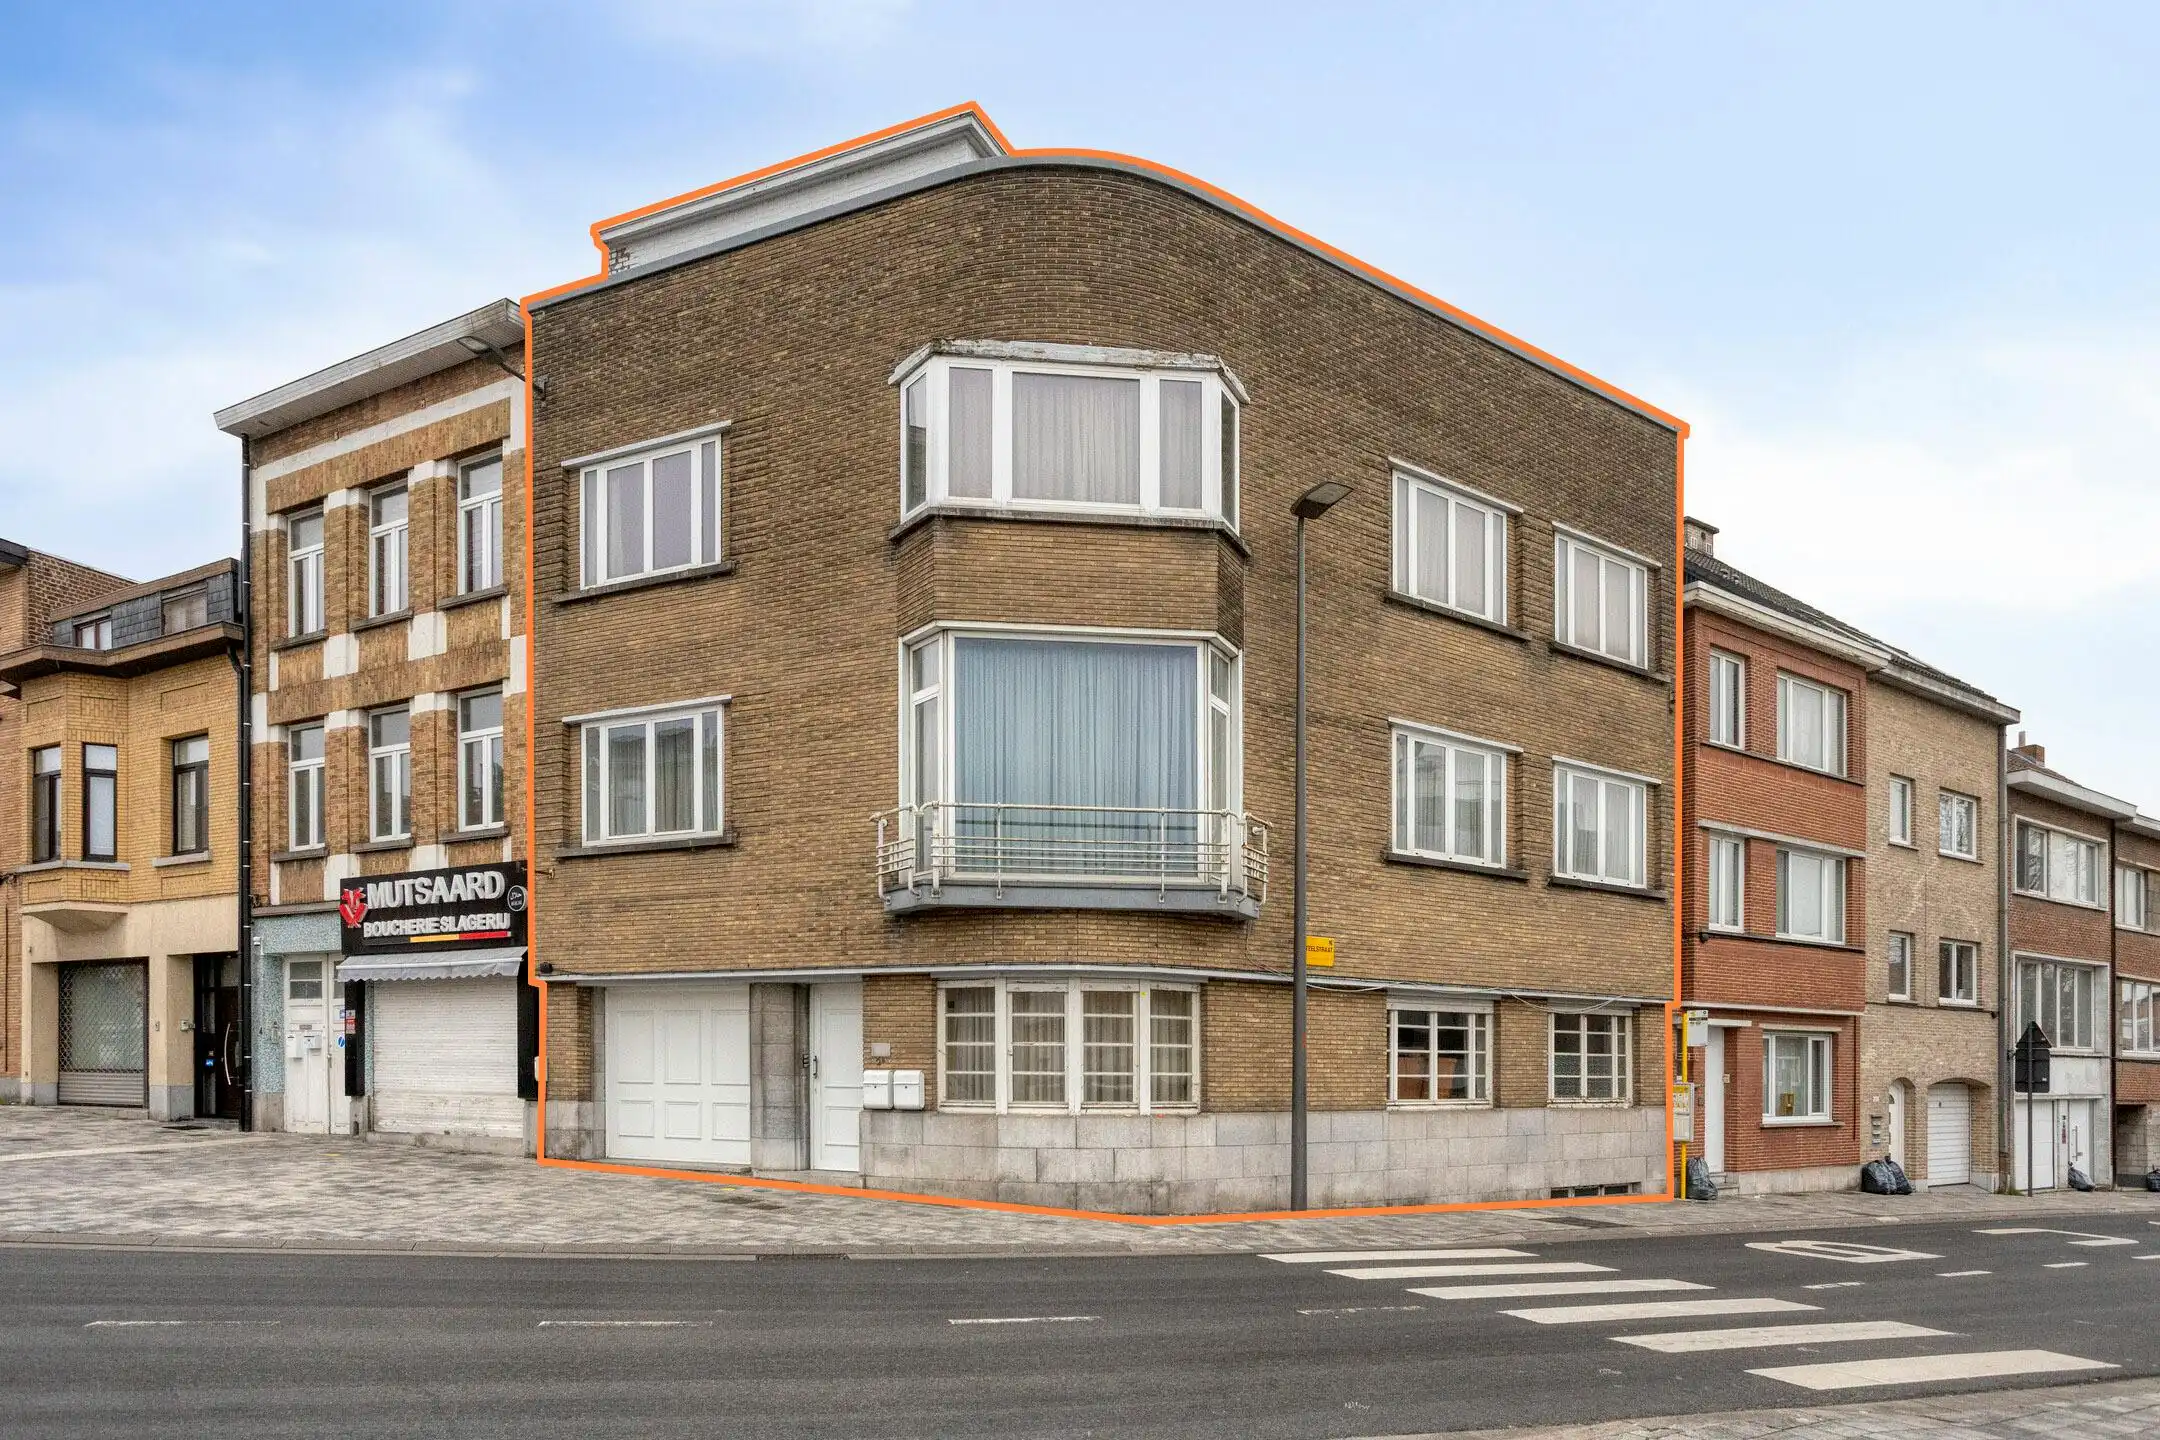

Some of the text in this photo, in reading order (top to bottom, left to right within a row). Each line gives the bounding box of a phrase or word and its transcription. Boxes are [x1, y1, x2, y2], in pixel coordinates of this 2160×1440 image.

[367, 871, 505, 909] MUTSAARD
[363, 912, 511, 938] BOUCHERIE SLAGERIJ
